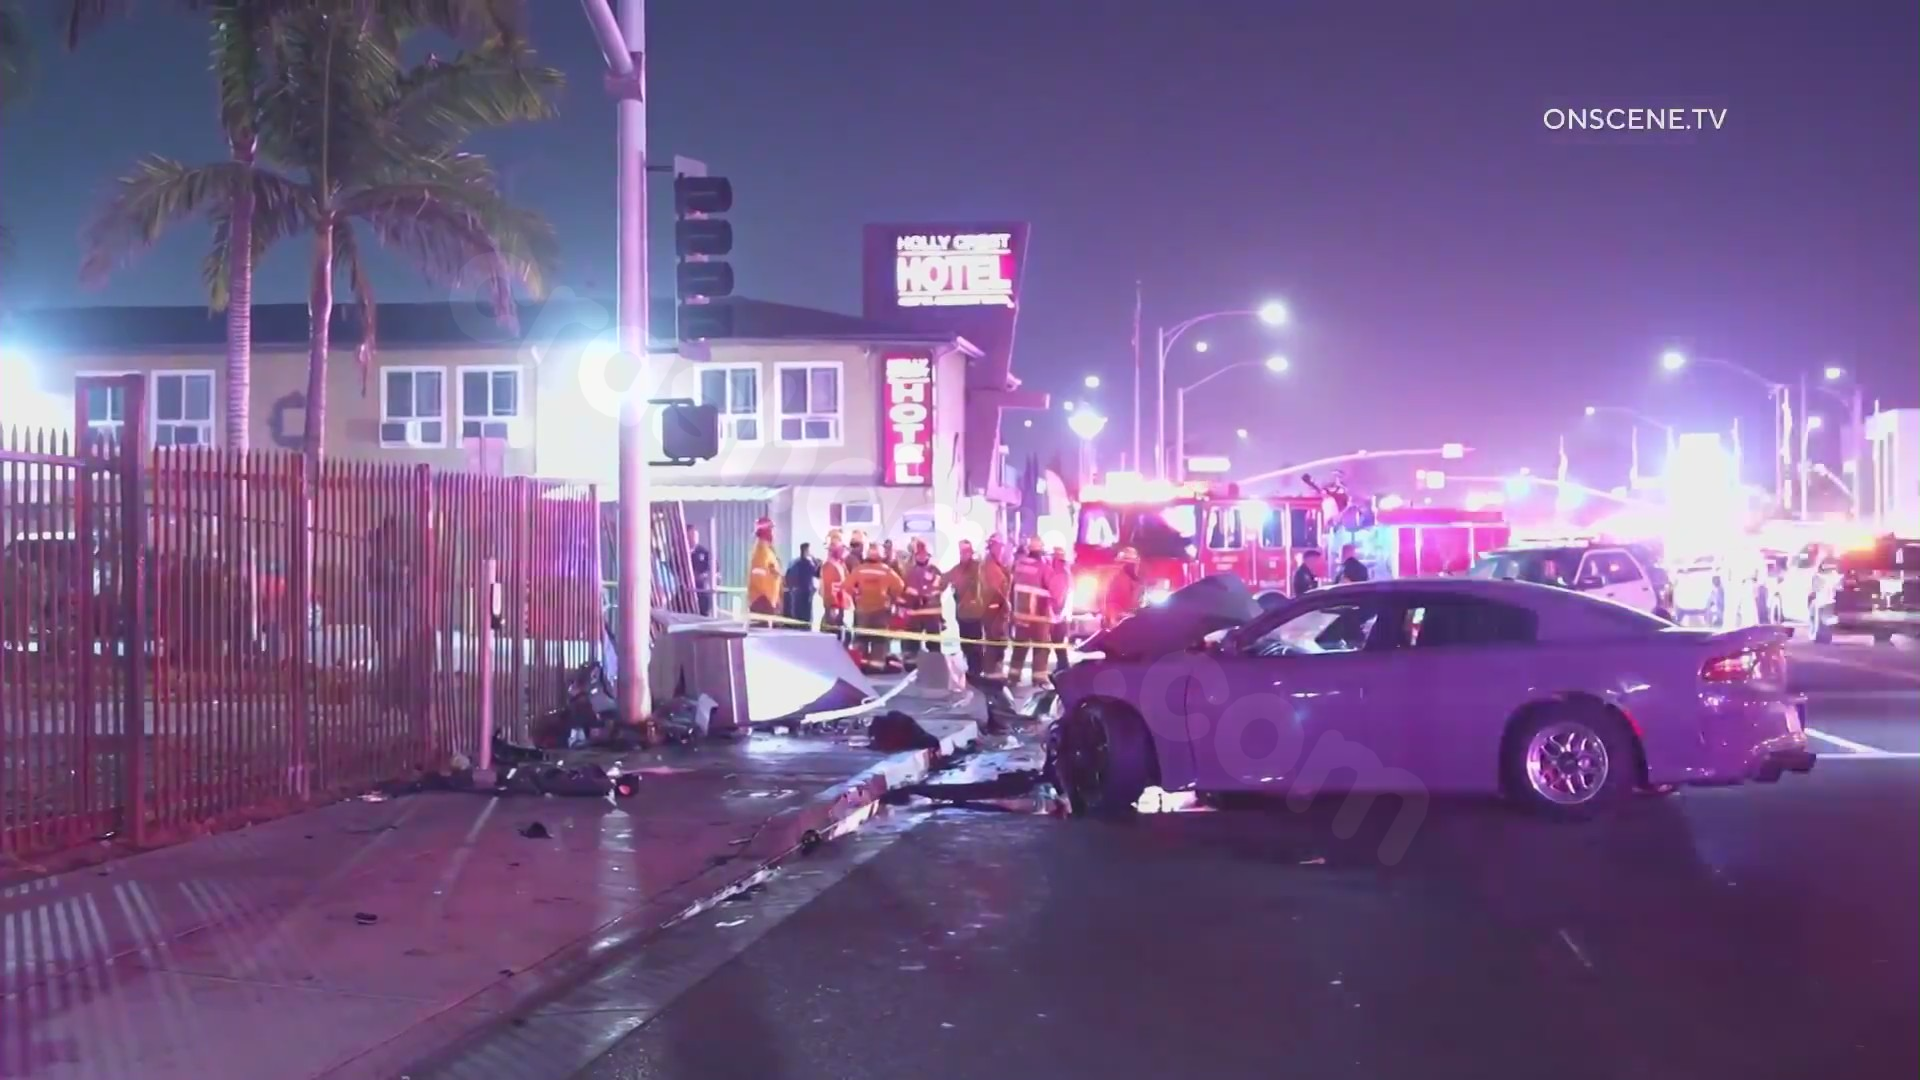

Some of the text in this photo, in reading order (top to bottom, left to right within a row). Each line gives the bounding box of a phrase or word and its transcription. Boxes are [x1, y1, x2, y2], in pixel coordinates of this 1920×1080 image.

[897, 235, 951, 250] HOLLY
[897, 256, 1012, 291] HOTEL
[889, 383, 927, 484] HOTEL
